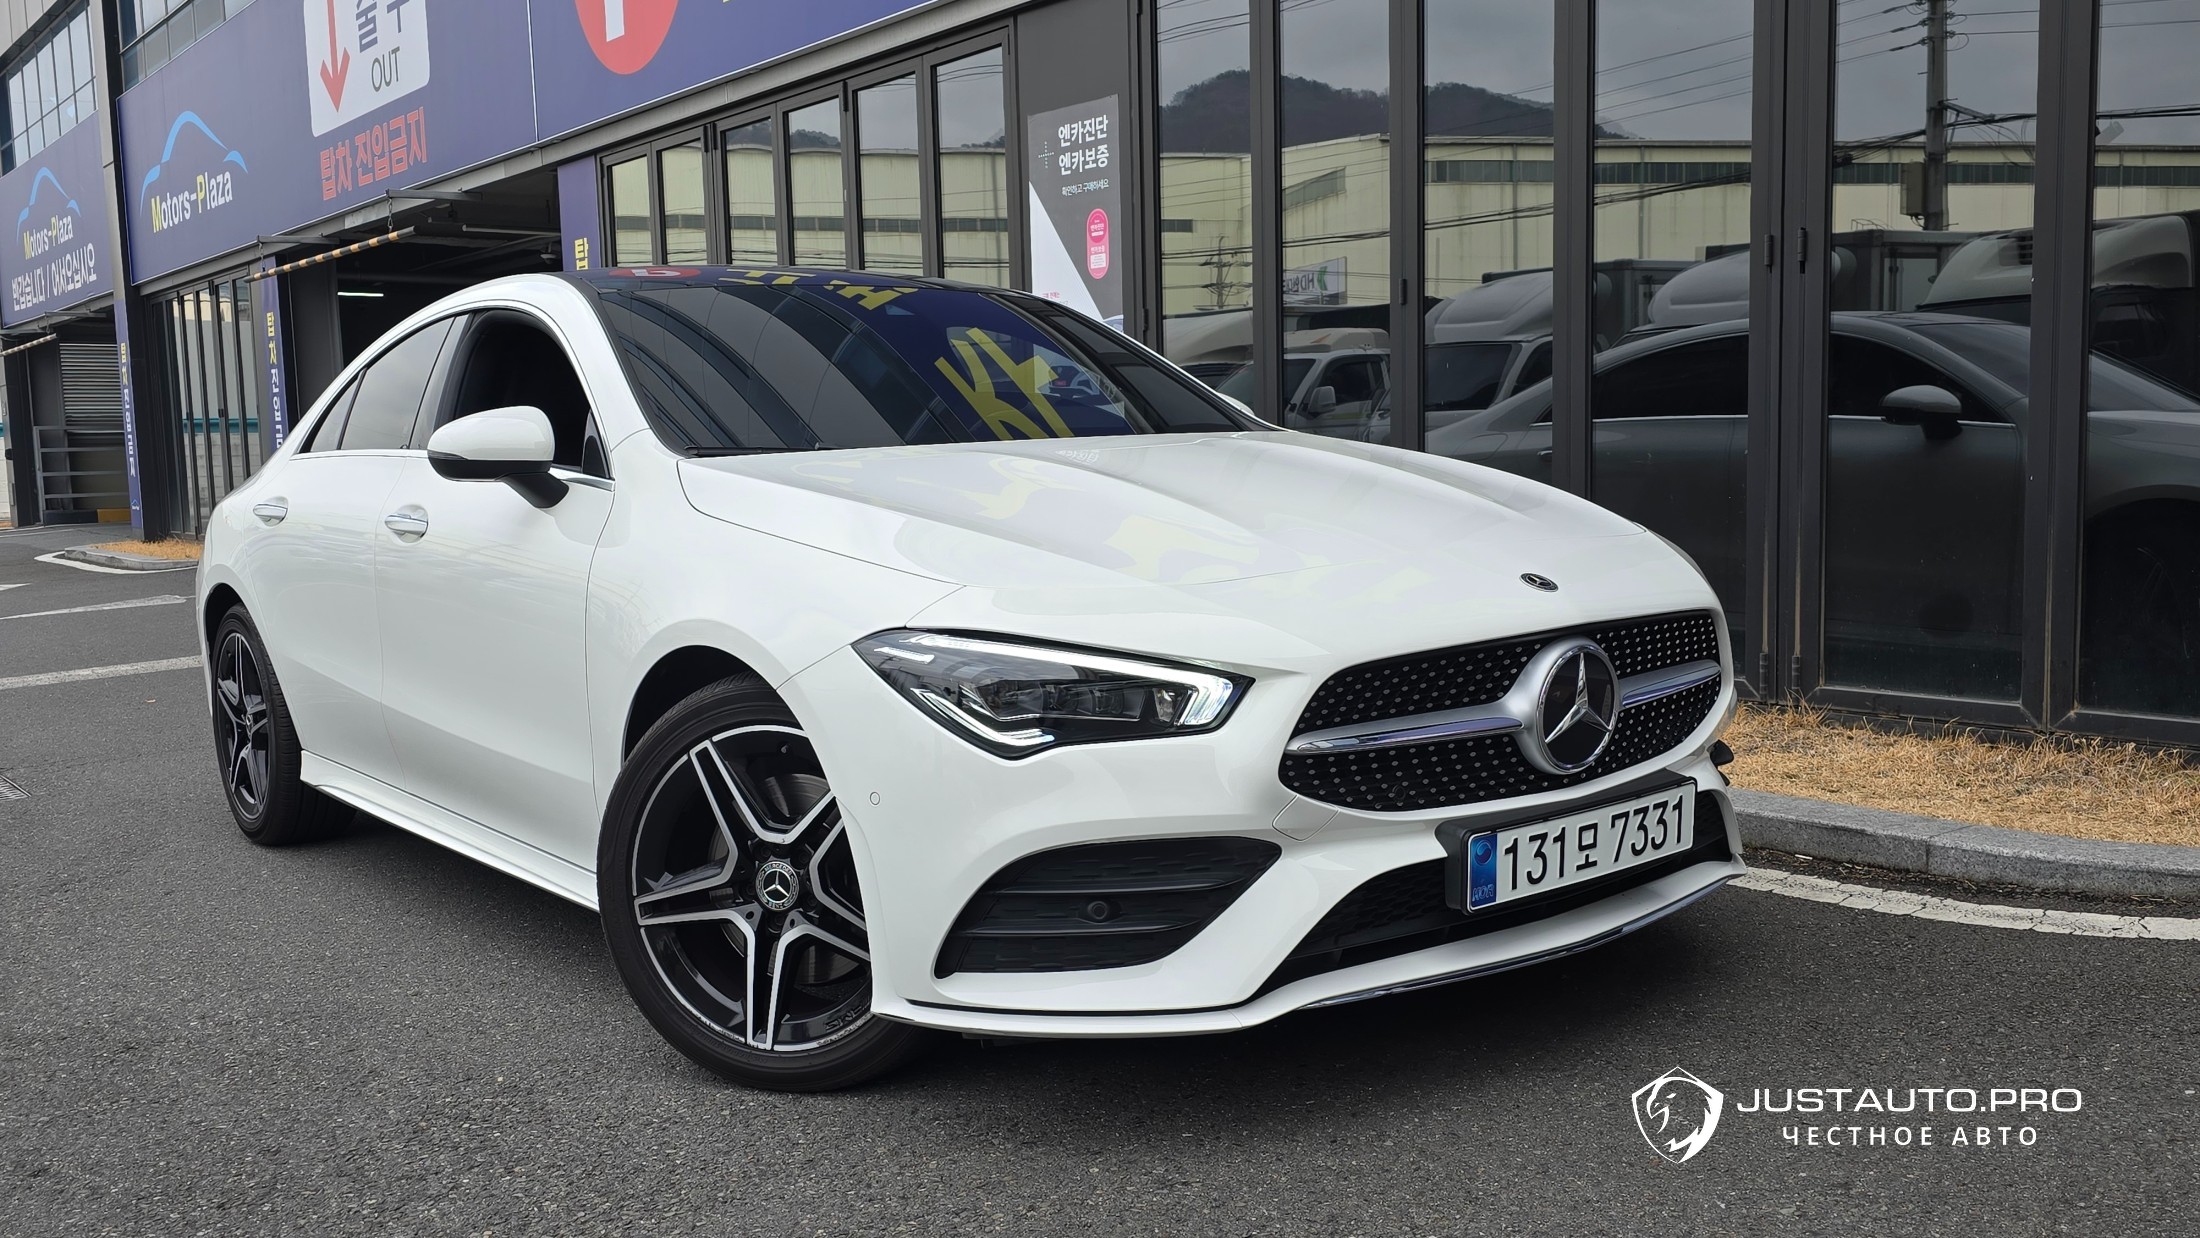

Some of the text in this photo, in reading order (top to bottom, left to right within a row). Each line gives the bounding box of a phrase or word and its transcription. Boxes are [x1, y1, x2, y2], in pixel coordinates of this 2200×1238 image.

[371, 46, 401, 92] OUT
[320, 106, 427, 201] 탑차 진입금지
[1058, 114, 1109, 148] 엔카진단
[1058, 144, 1110, 176] 엔카보증
[151, 171, 233, 233] Motors-Plaza
[23, 214, 74, 260] Motors-Plaza
[11, 265, 46, 312] 반갑습니다
[51, 242, 97, 297] 어서오십시오
[270, 368, 284, 450] 진입금
[1503, 794, 1684, 891] 131모 7331
